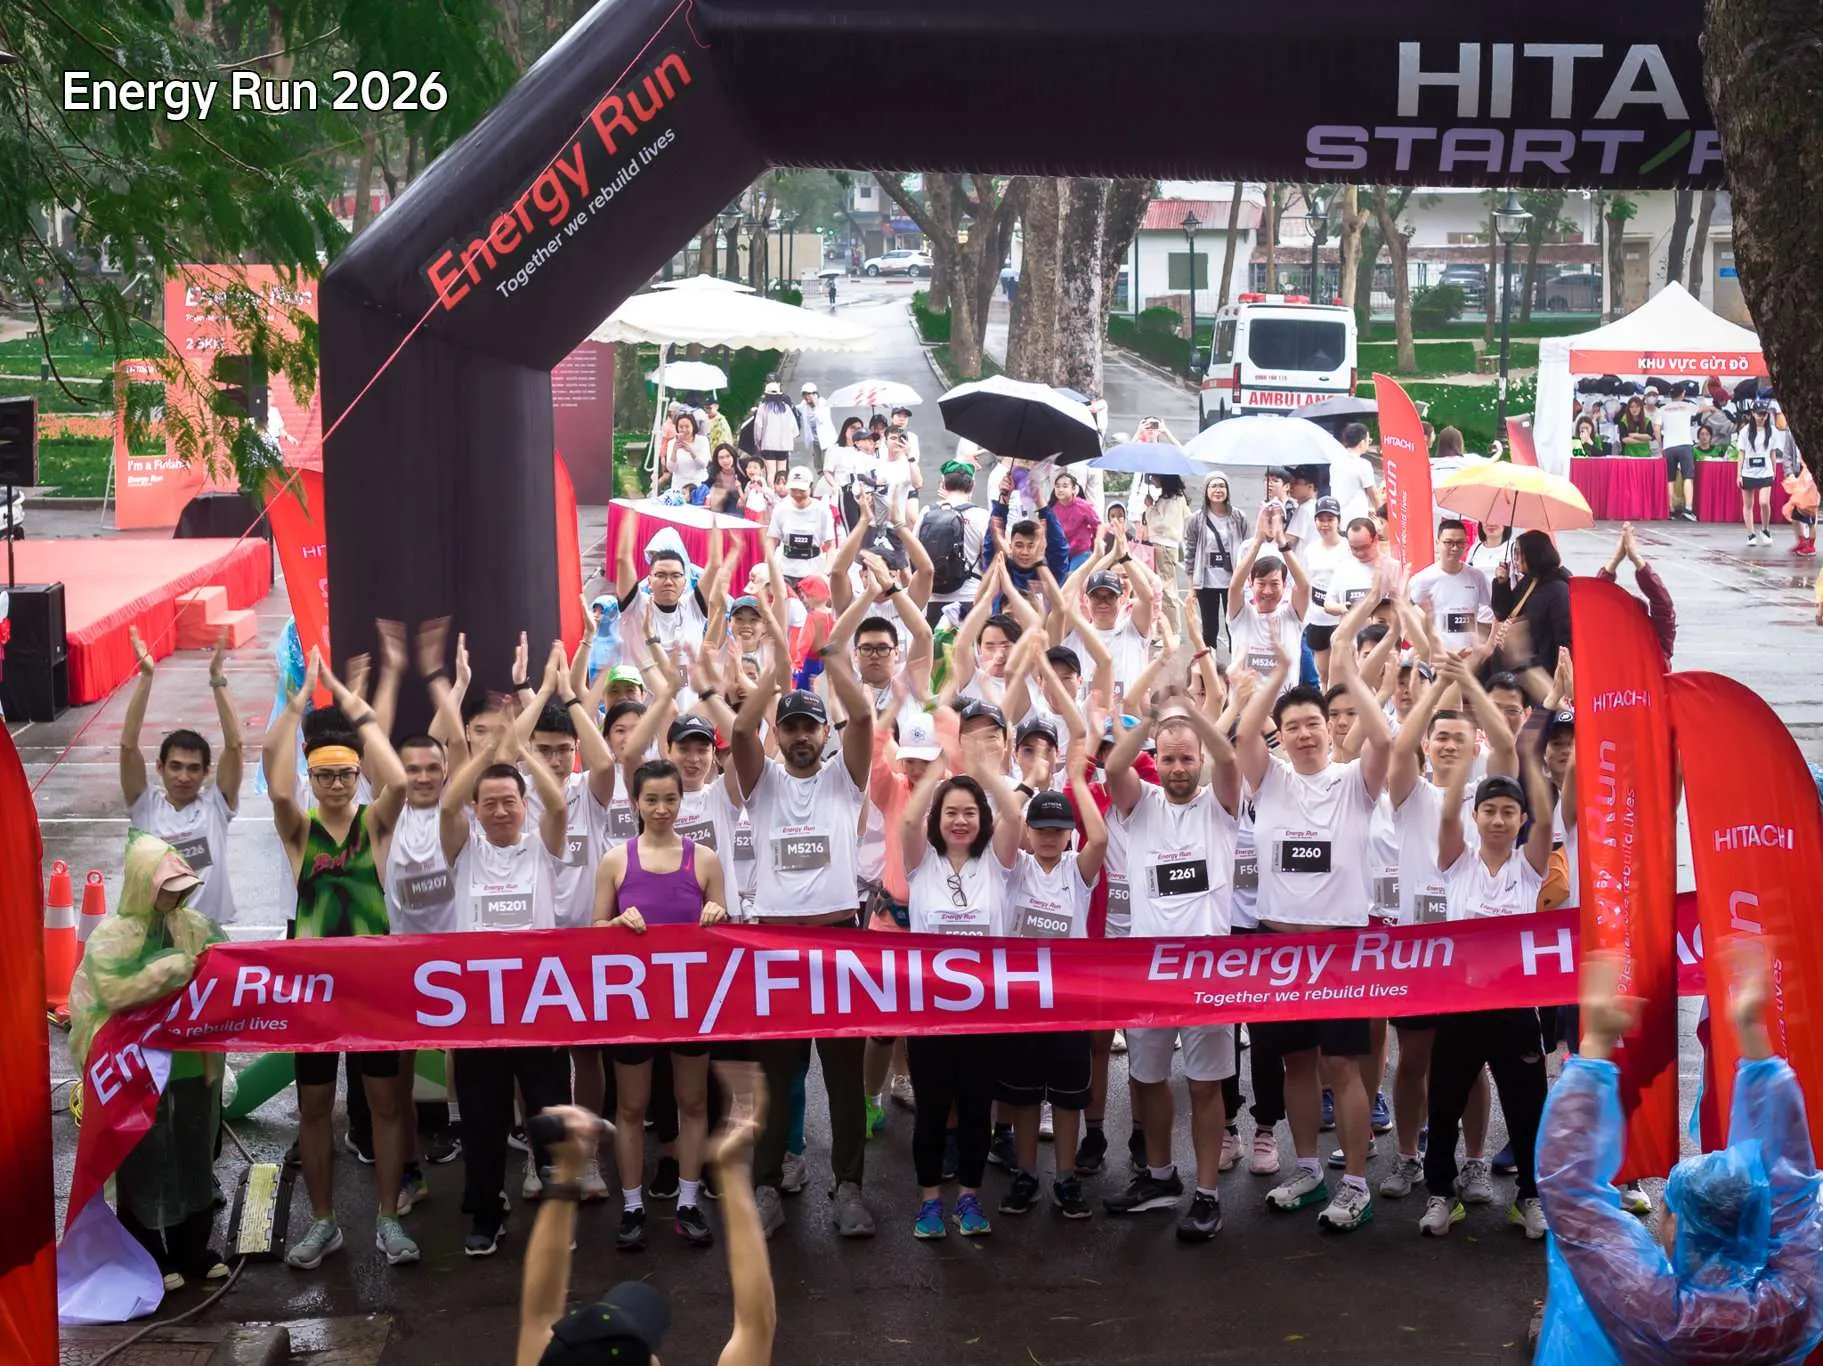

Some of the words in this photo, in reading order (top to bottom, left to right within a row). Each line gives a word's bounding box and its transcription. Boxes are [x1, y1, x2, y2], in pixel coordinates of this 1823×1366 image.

[427, 142, 590, 311] Energy
[588, 52, 692, 155] Run
[496, 233, 563, 299] Together
[564, 210, 588, 237] we
[588, 159, 641, 215] rebuild
[639, 128, 676, 165] lives
[1637, 358, 1665, 369] KHU
[1669, 358, 1697, 372] VỰC
[1700, 355, 1726, 370] GỬI
[1729, 356, 1749, 370] ĐỒ
[1384, 435, 1415, 452] HITACHI
[782, 826, 803, 834] Energy
[1285, 830, 1305, 838] Energy
[1714, 824, 1794, 852] HITACHI
[787, 842, 824, 855] M5216
[1157, 852, 1178, 860] Energy
[1291, 847, 1322, 858] 2260
[1169, 868, 1197, 881] 2261
[488, 900, 527, 913] M5201
[1028, 897, 1050, 907] Energy
[1050, 901, 1062, 909] Run
[1026, 915, 1068, 933] M5000
[1148, 943, 1337, 987] Energy
[1351, 932, 1455, 972] Run
[232, 965, 334, 1007] Run
[413, 947, 1054, 1034] START/FINISH
[1193, 990, 1271, 1008] Together
[1275, 991, 1299, 1003] we
[1304, 986, 1364, 1001] rebuild
[1369, 983, 1408, 997] lives
[186, 1020, 246, 1038] rebuild
[249, 1016, 288, 1031] lives
